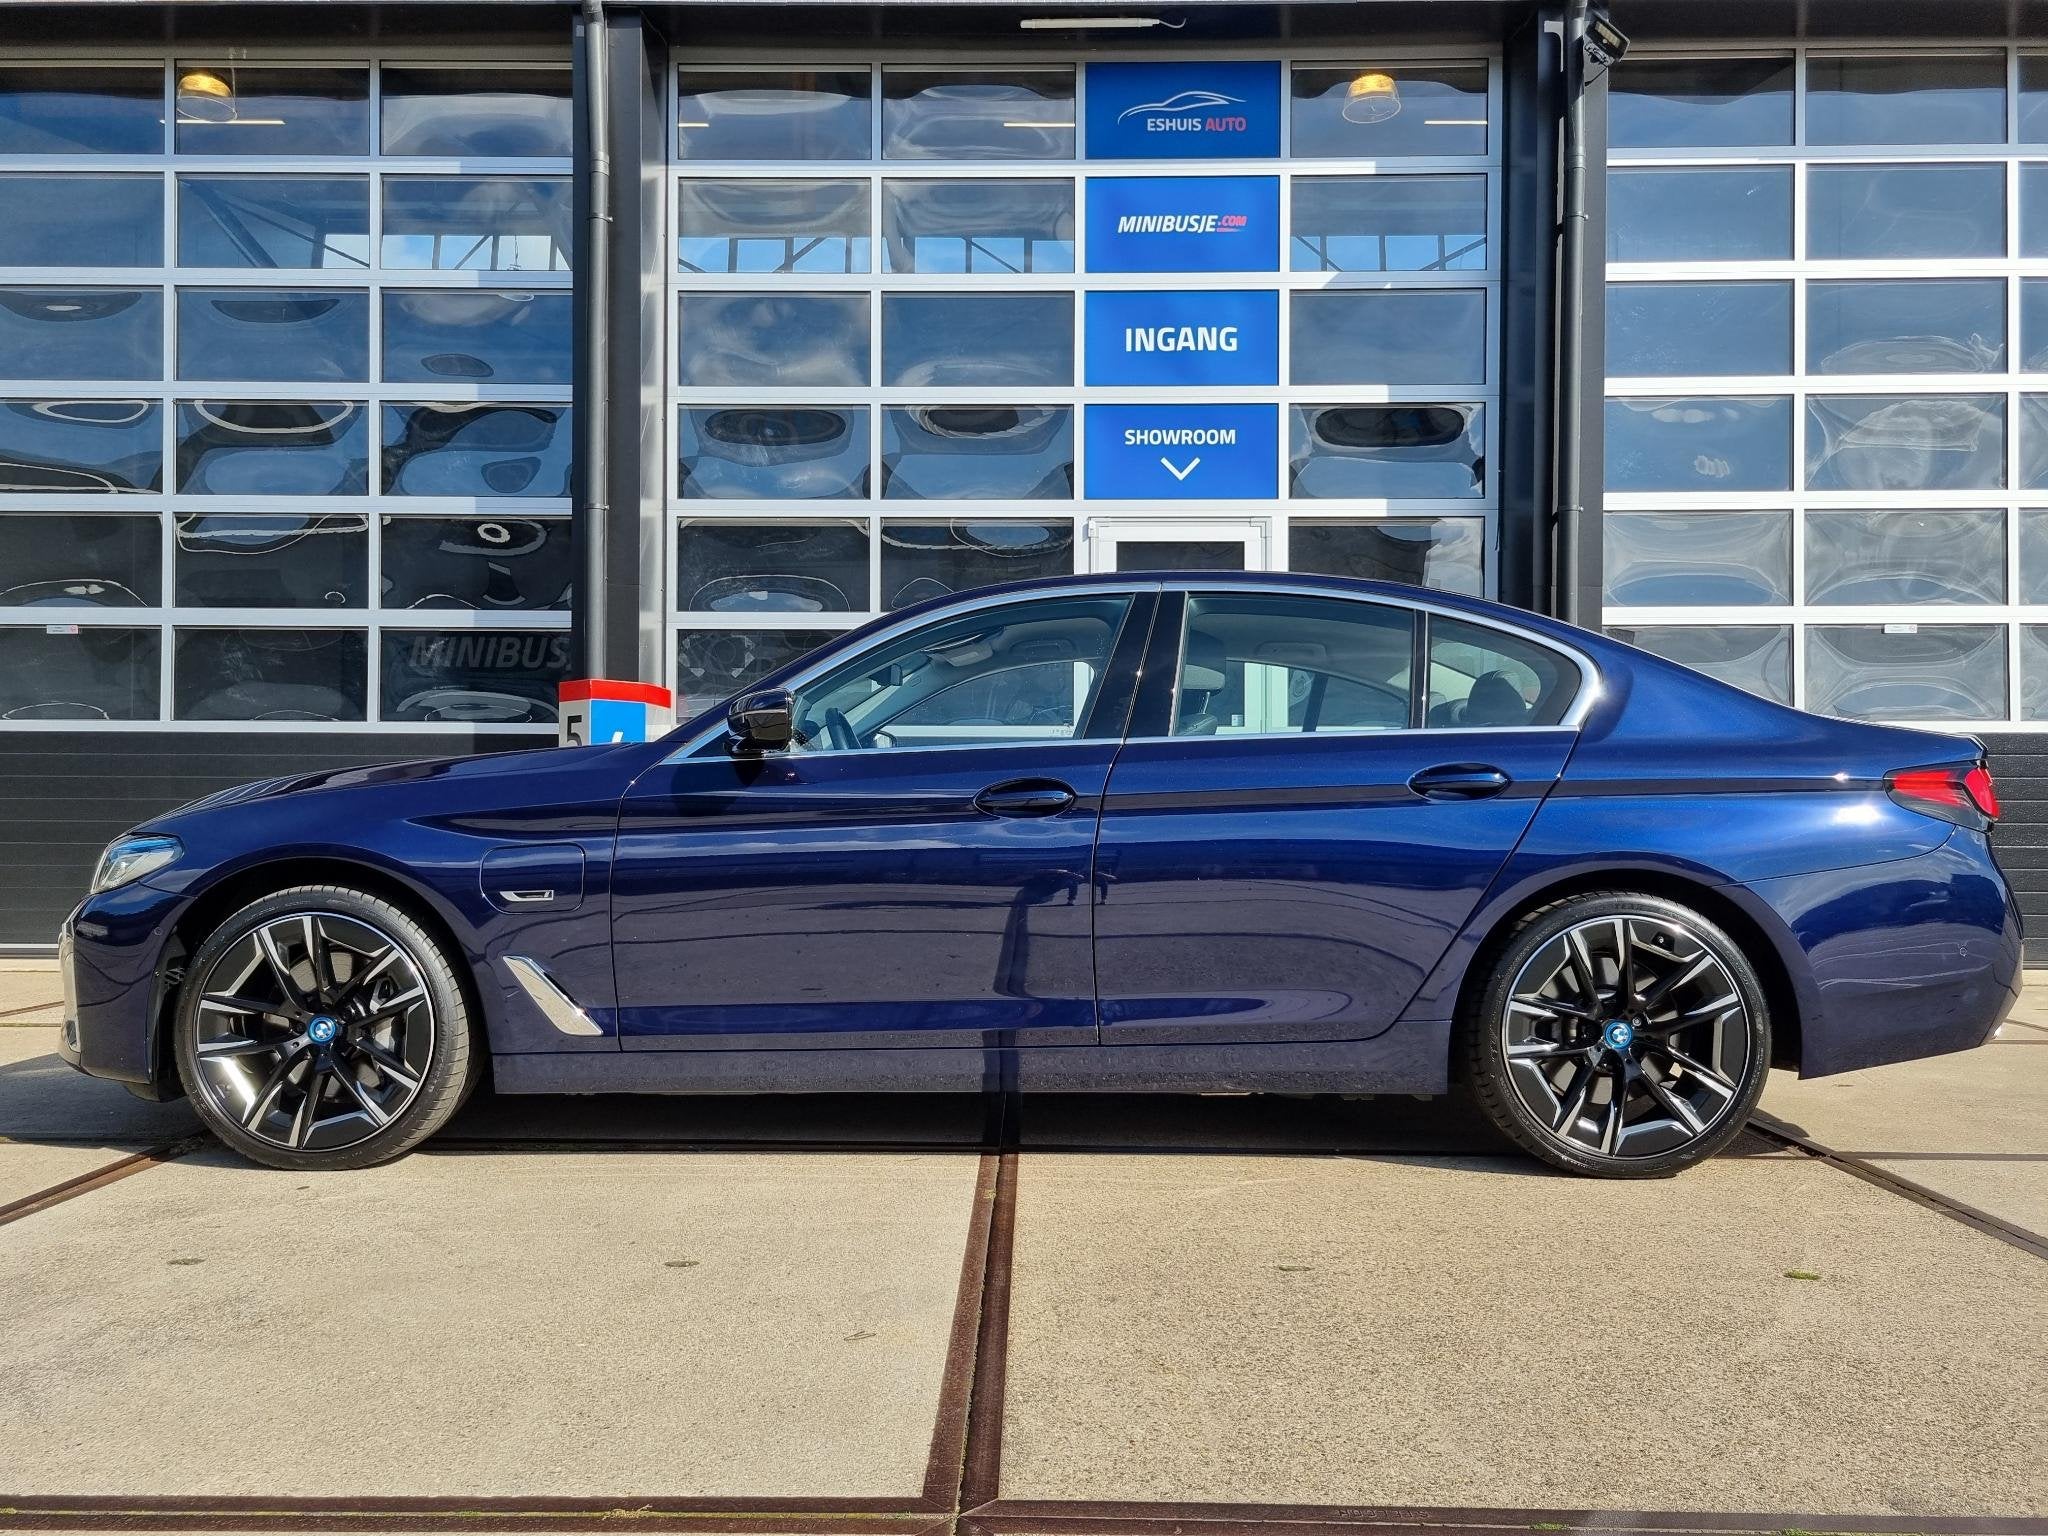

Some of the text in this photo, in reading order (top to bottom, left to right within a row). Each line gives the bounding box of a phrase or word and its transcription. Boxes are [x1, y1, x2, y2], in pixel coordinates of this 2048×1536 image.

[1147, 117, 1247, 132] ESHUIS AUTO
[1125, 326, 1238, 352] INGANG
[1124, 429, 1236, 445] SHOWROOM
[408, 635, 573, 671] MINIBUS
[566, 714, 583, 748] 5
